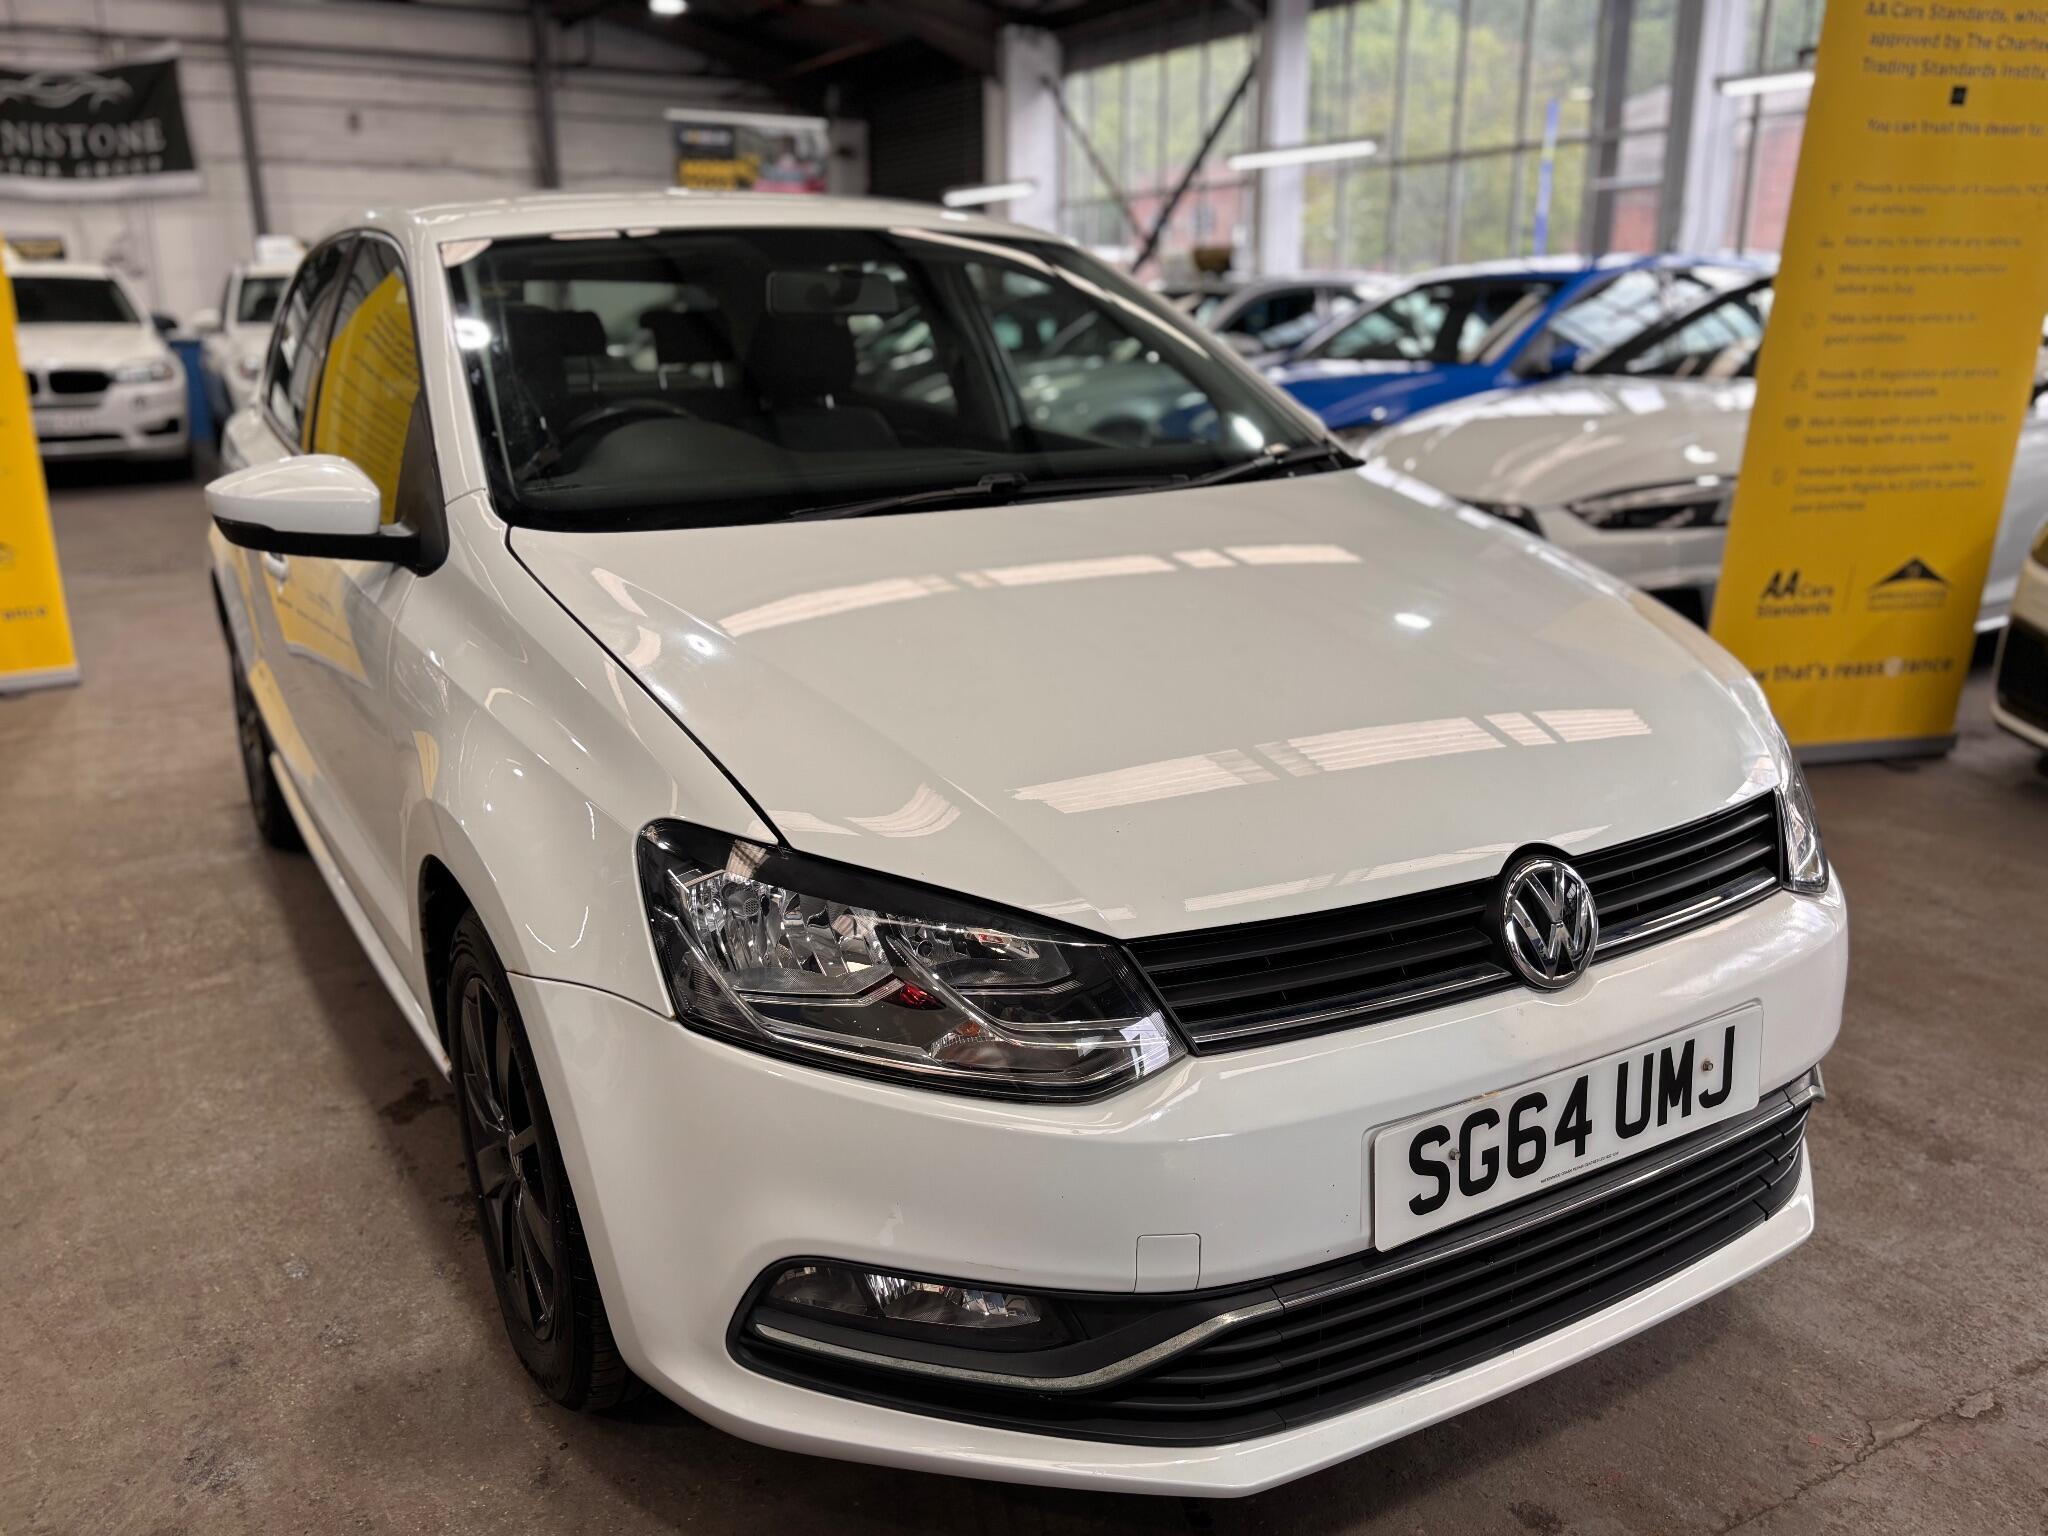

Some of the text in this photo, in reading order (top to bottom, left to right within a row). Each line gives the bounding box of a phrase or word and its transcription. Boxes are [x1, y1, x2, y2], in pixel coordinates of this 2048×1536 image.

[1891, 2, 1924, 19] Cars
[1968, 32, 1992, 48] The
[1862, 57, 1915, 78] Trading
[1920, 60, 1996, 77] Standards
[1760, 570, 1834, 600] AA Cars
[1756, 602, 1831, 620] Standards
[1774, 663, 1828, 682] that's
[1408, 1025, 1736, 1217] SG64 UMJ
